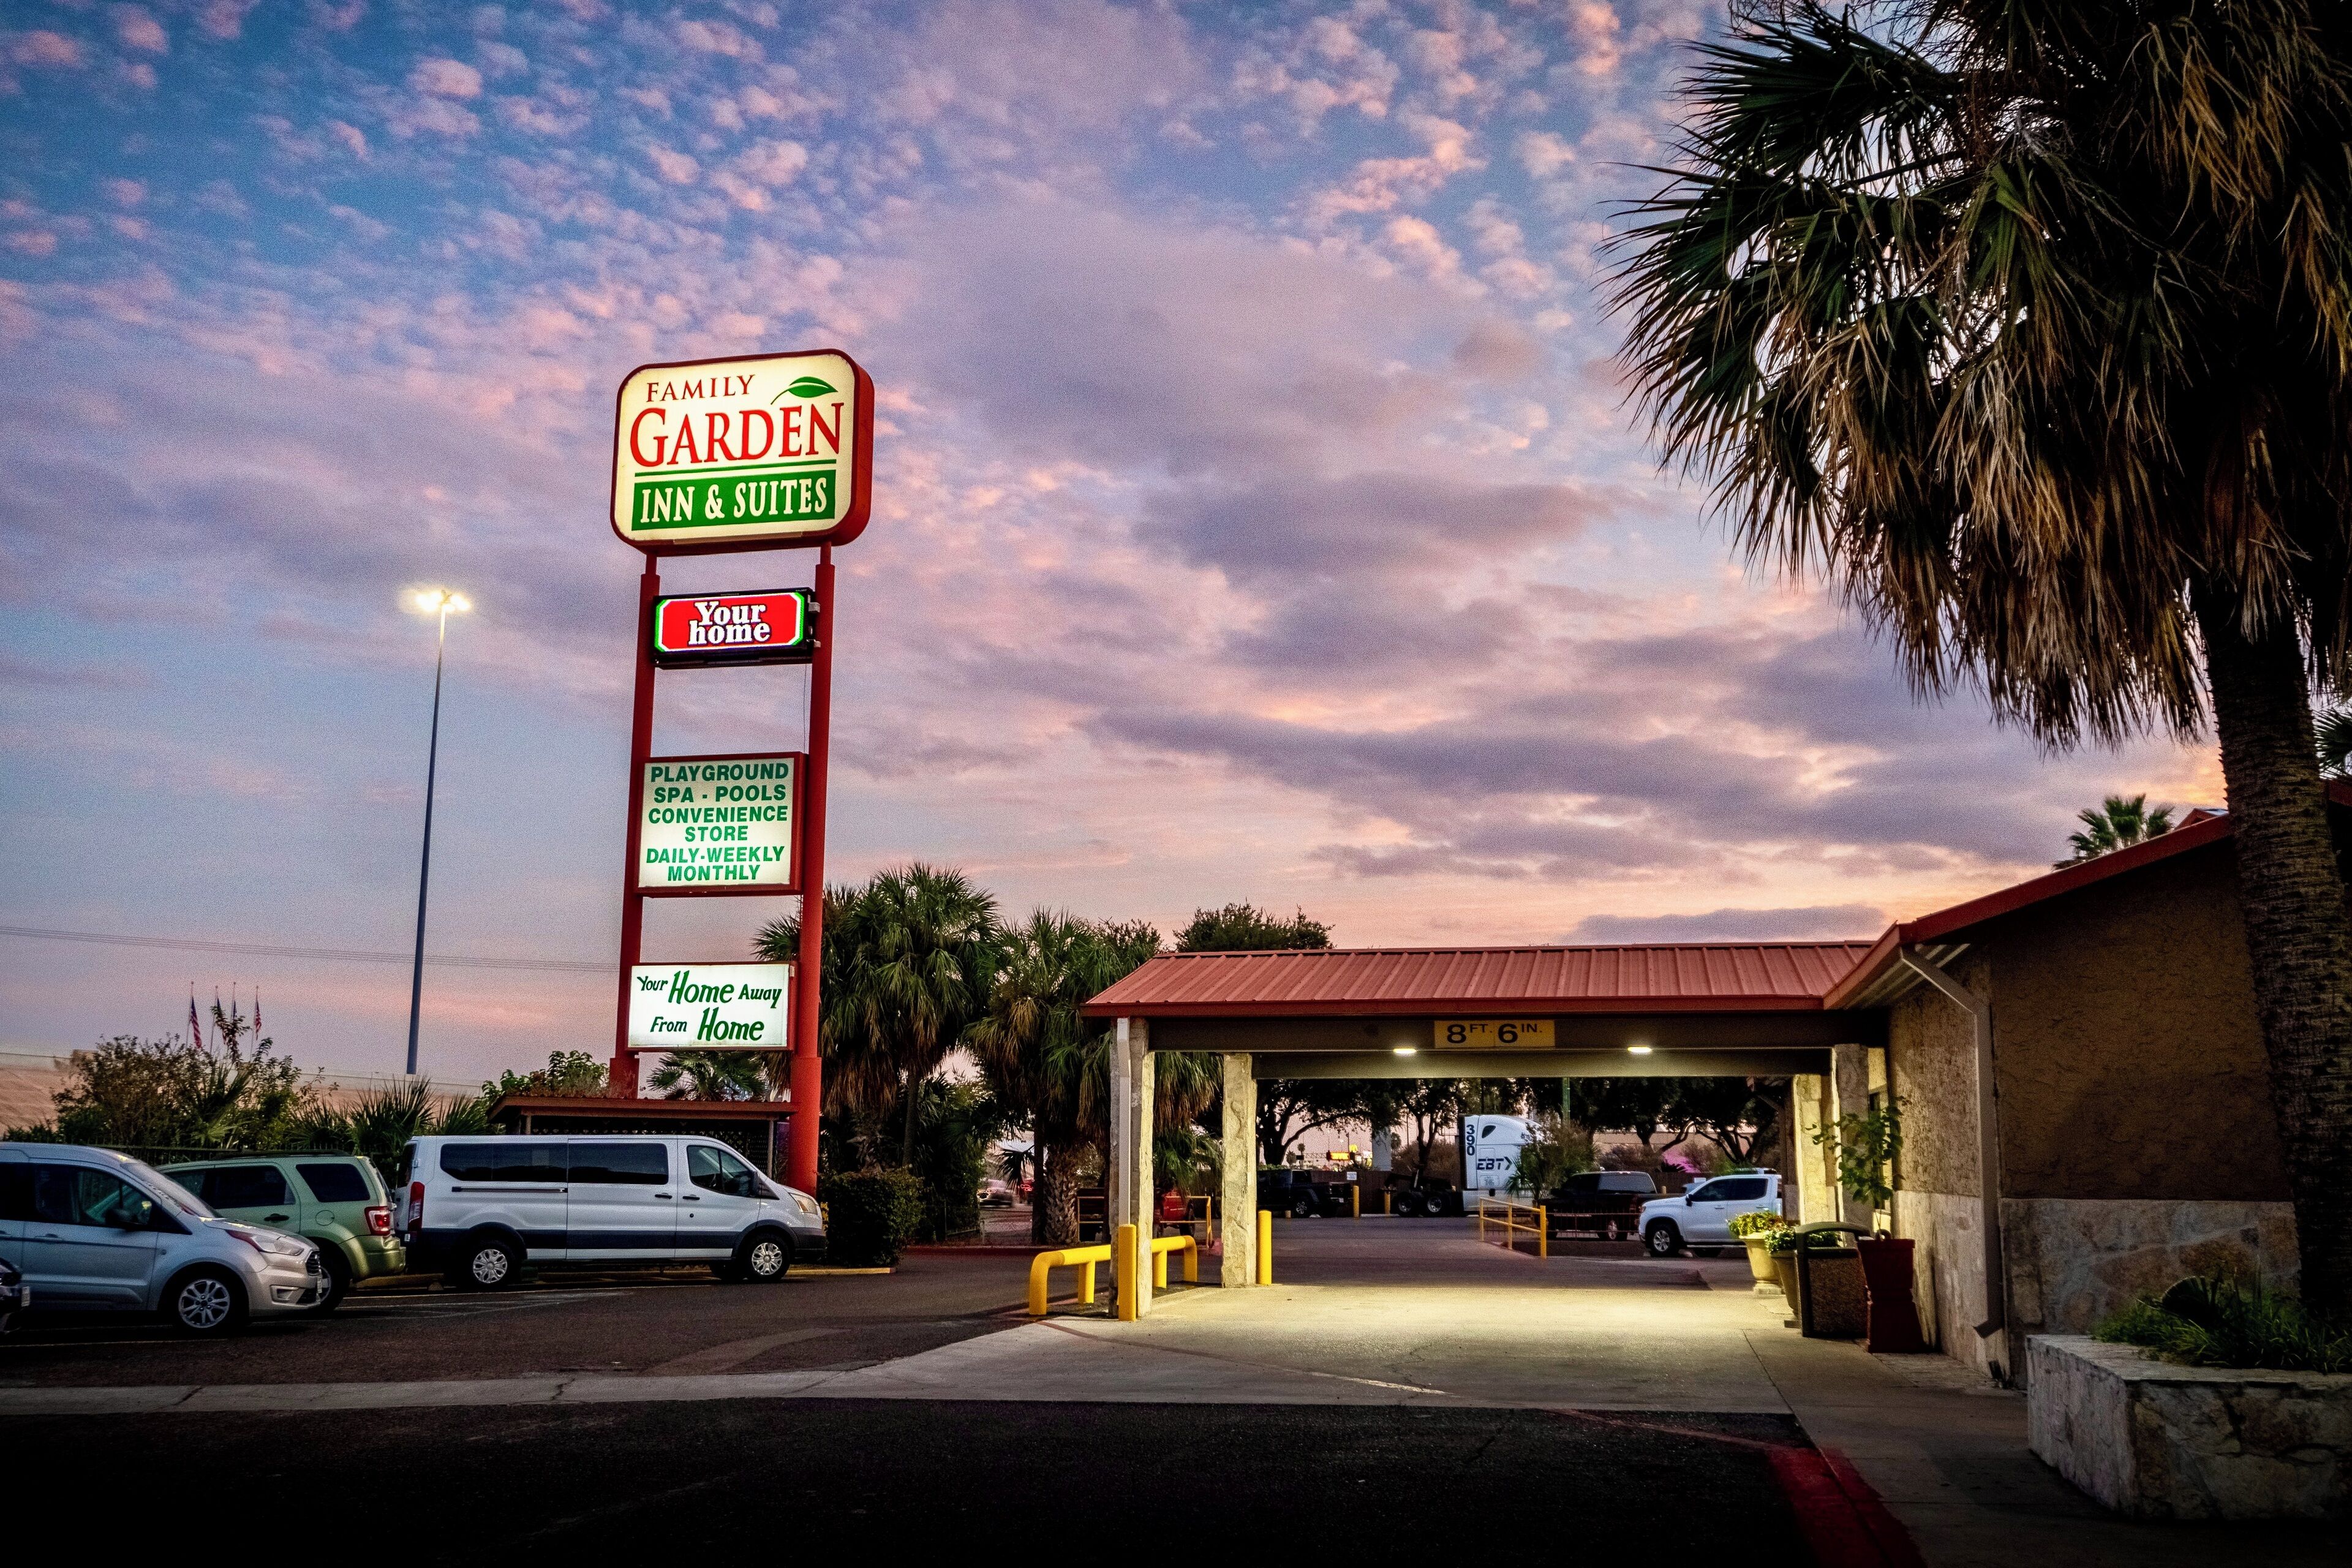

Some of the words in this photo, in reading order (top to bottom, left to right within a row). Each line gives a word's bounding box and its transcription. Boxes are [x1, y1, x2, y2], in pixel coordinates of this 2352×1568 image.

[646, 374, 755, 402] FAMILY
[630, 402, 845, 467] GARDEN
[640, 486, 695, 524] INN
[705, 484, 725, 520] &
[734, 477, 827, 519] SUITES
[694, 601, 766, 625] Your
[688, 620, 771, 645] home
[650, 763, 789, 782] PLAYGROUND
[654, 786, 694, 803] SPA
[715, 784, 786, 802] POOLS
[648, 805, 788, 824] CONVENIENCE
[685, 826, 748, 842] STORE
[668, 864, 761, 881] MONTHLY
[637, 976, 668, 991] Your
[668, 970, 734, 1005] Home
[738, 984, 782, 1009] Away
[650, 1016, 687, 1033] From
[697, 1006, 764, 1041] Home
[1447, 1023, 1467, 1044] 8
[1498, 1023, 1518, 1044] 6
[1466, 1124, 1476, 1156] 390
